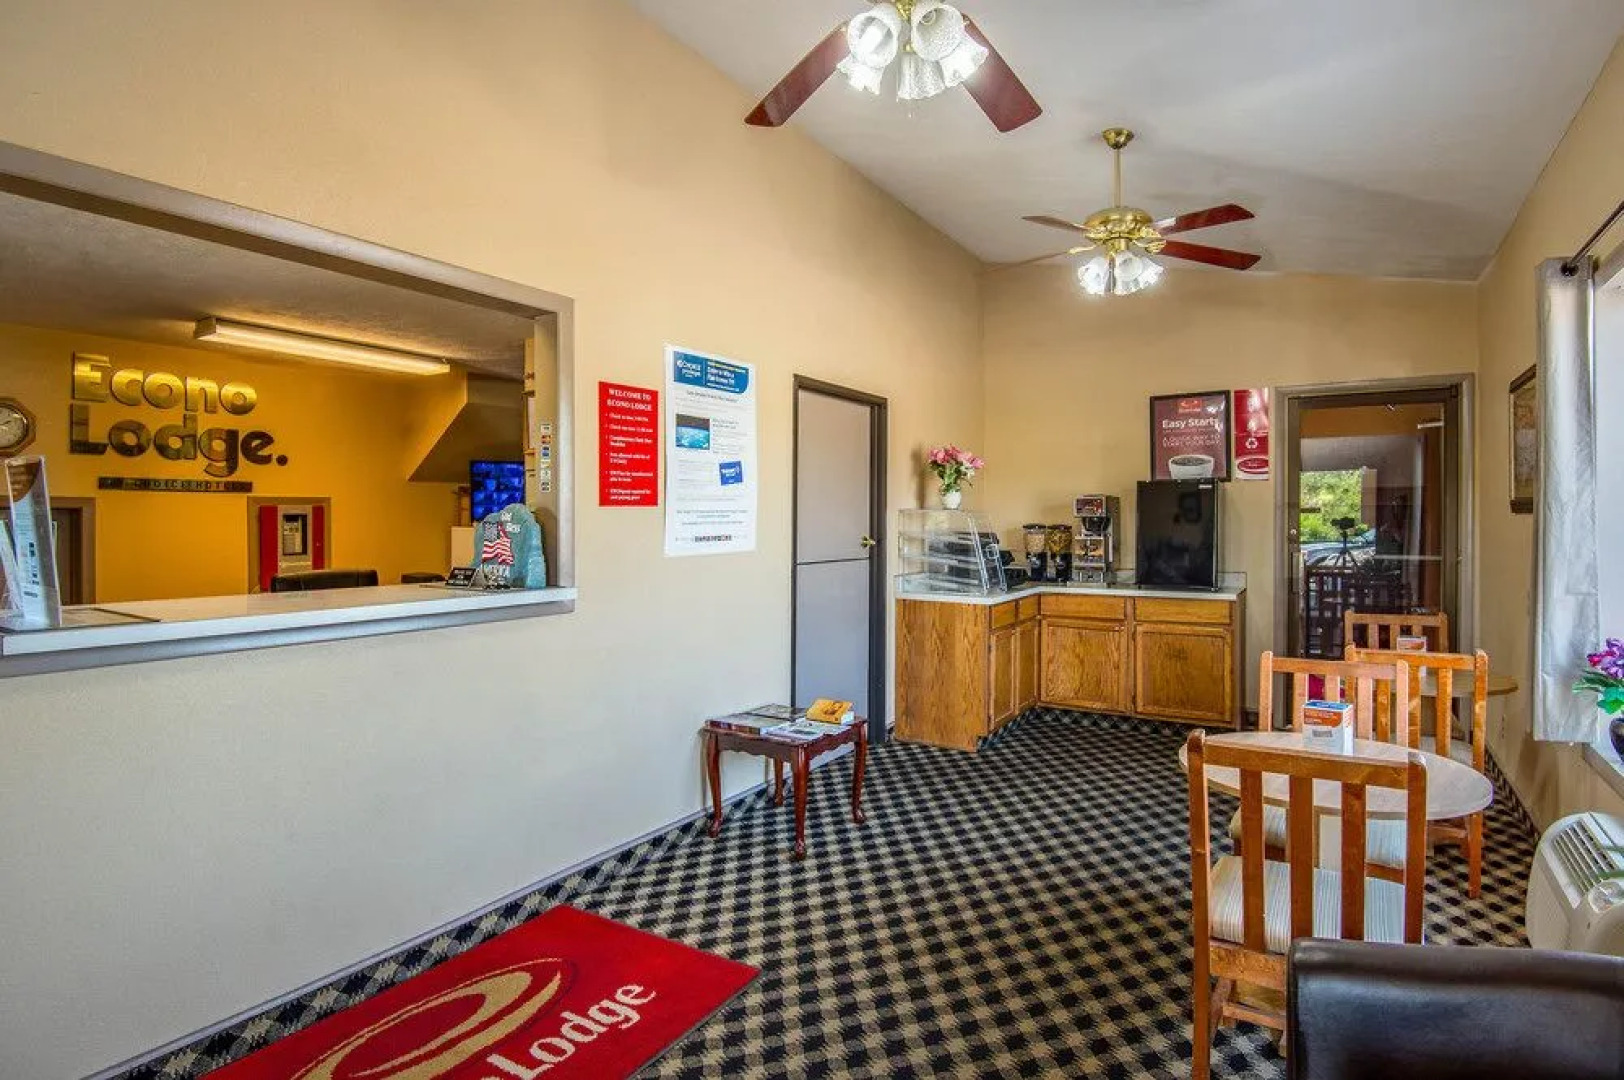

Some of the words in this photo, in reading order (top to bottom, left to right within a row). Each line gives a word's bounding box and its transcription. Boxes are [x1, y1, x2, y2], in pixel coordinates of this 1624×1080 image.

[72, 351, 257, 415] Econo
[608, 387, 643, 400] WELCOME
[642, 393, 652, 401] TO
[606, 398, 631, 408] ECONO
[631, 402, 652, 412] LODGE
[1162, 419, 1187, 429] Easy
[69, 402, 289, 478] Lodge.
[486, 985, 656, 1080] Lodge
